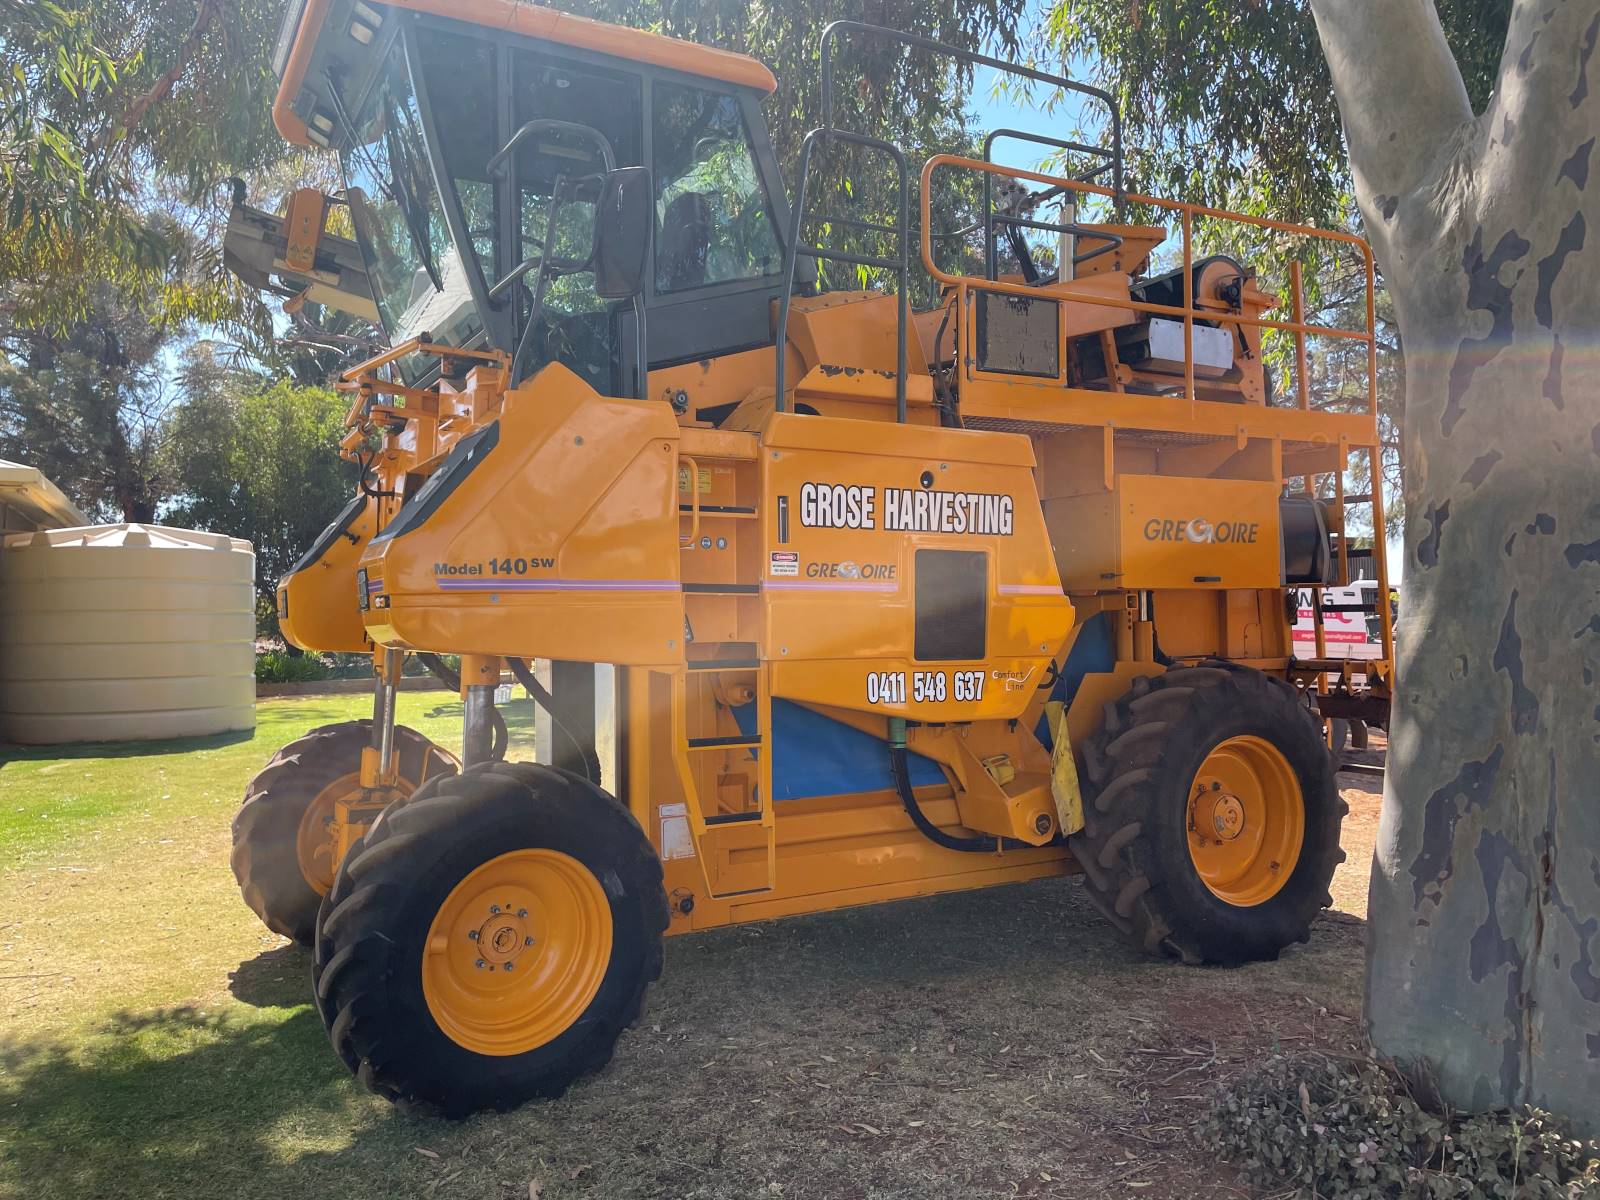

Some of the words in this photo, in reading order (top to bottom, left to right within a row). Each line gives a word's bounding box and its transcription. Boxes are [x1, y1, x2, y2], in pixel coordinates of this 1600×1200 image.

[800, 482, 875, 530] GROSE
[884, 487, 1013, 536] HARVESTING
[1143, 517, 1259, 544] GREGOIRE
[434, 563, 483, 575] Model
[489, 558, 528, 575] 140
[806, 561, 896, 580] GREGOIRE
[867, 671, 907, 704] 0411
[913, 671, 947, 702] 548
[954, 670, 985, 701] 637
